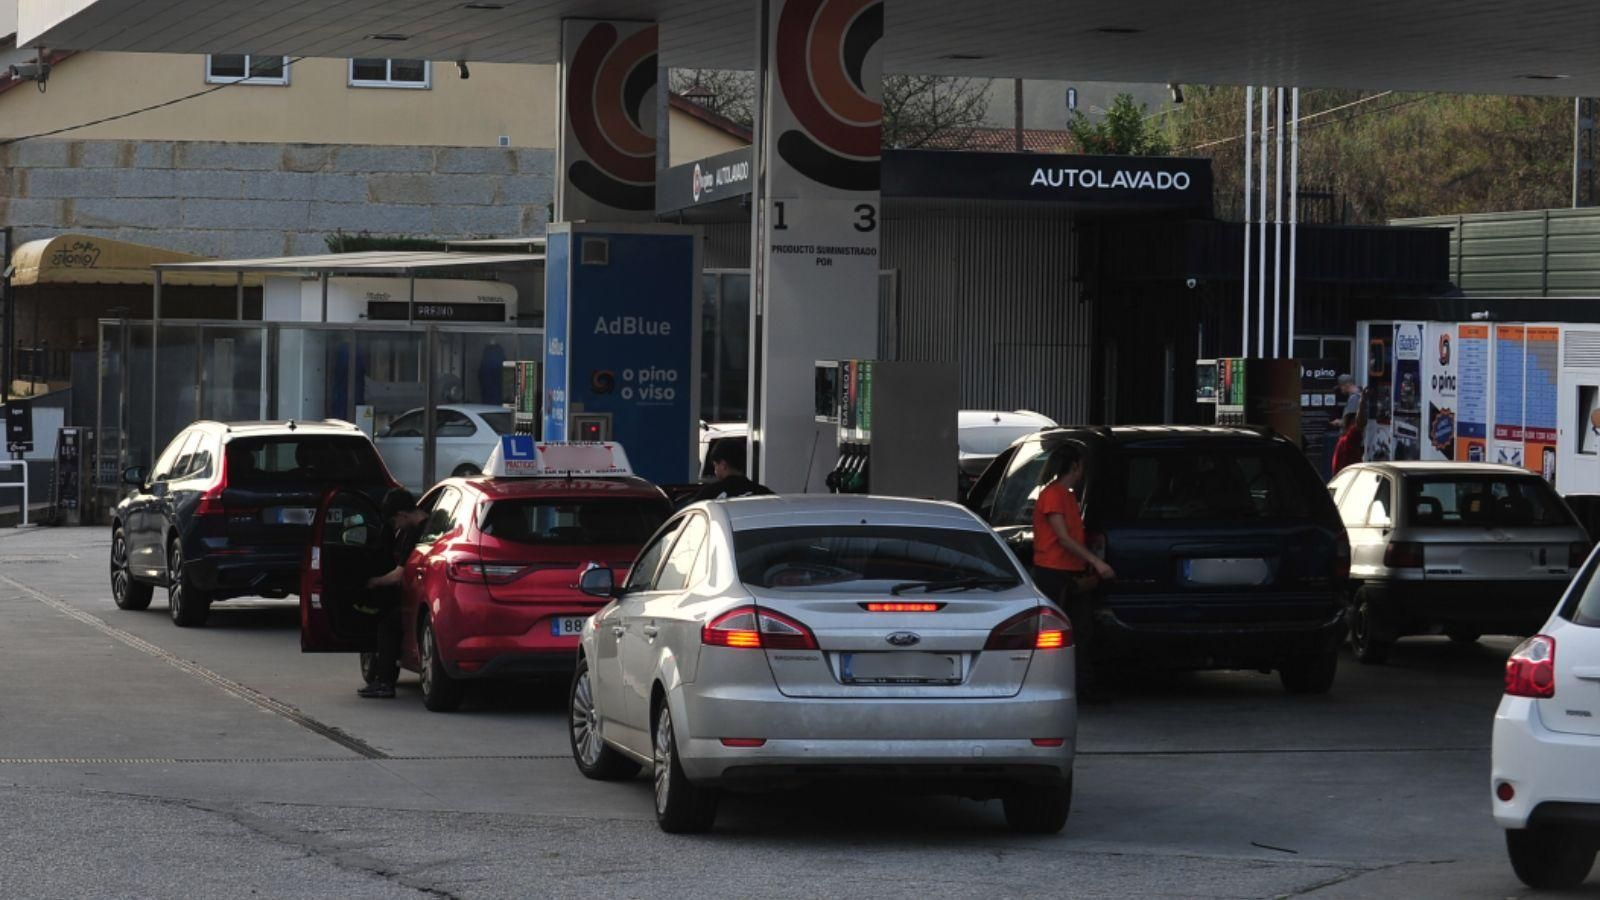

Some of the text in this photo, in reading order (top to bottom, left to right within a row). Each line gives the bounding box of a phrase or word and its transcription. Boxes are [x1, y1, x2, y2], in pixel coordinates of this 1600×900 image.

[716, 161, 749, 187] AUTOLAVADO
[1030, 167, 1190, 190] AUTOLAVADO
[774, 201, 877, 233] 1 3
[771, 244, 878, 256] PRODUCTO SUMINISTRADO
[816, 257, 833, 267] POR
[594, 316, 672, 336] AdBlue
[623, 365, 678, 384] o pino
[1314, 367, 1336, 379] pino
[1431, 374, 1438, 390] o
[621, 384, 675, 400] o viso
[511, 438, 527, 456] L
[564, 618, 587, 633] 88
